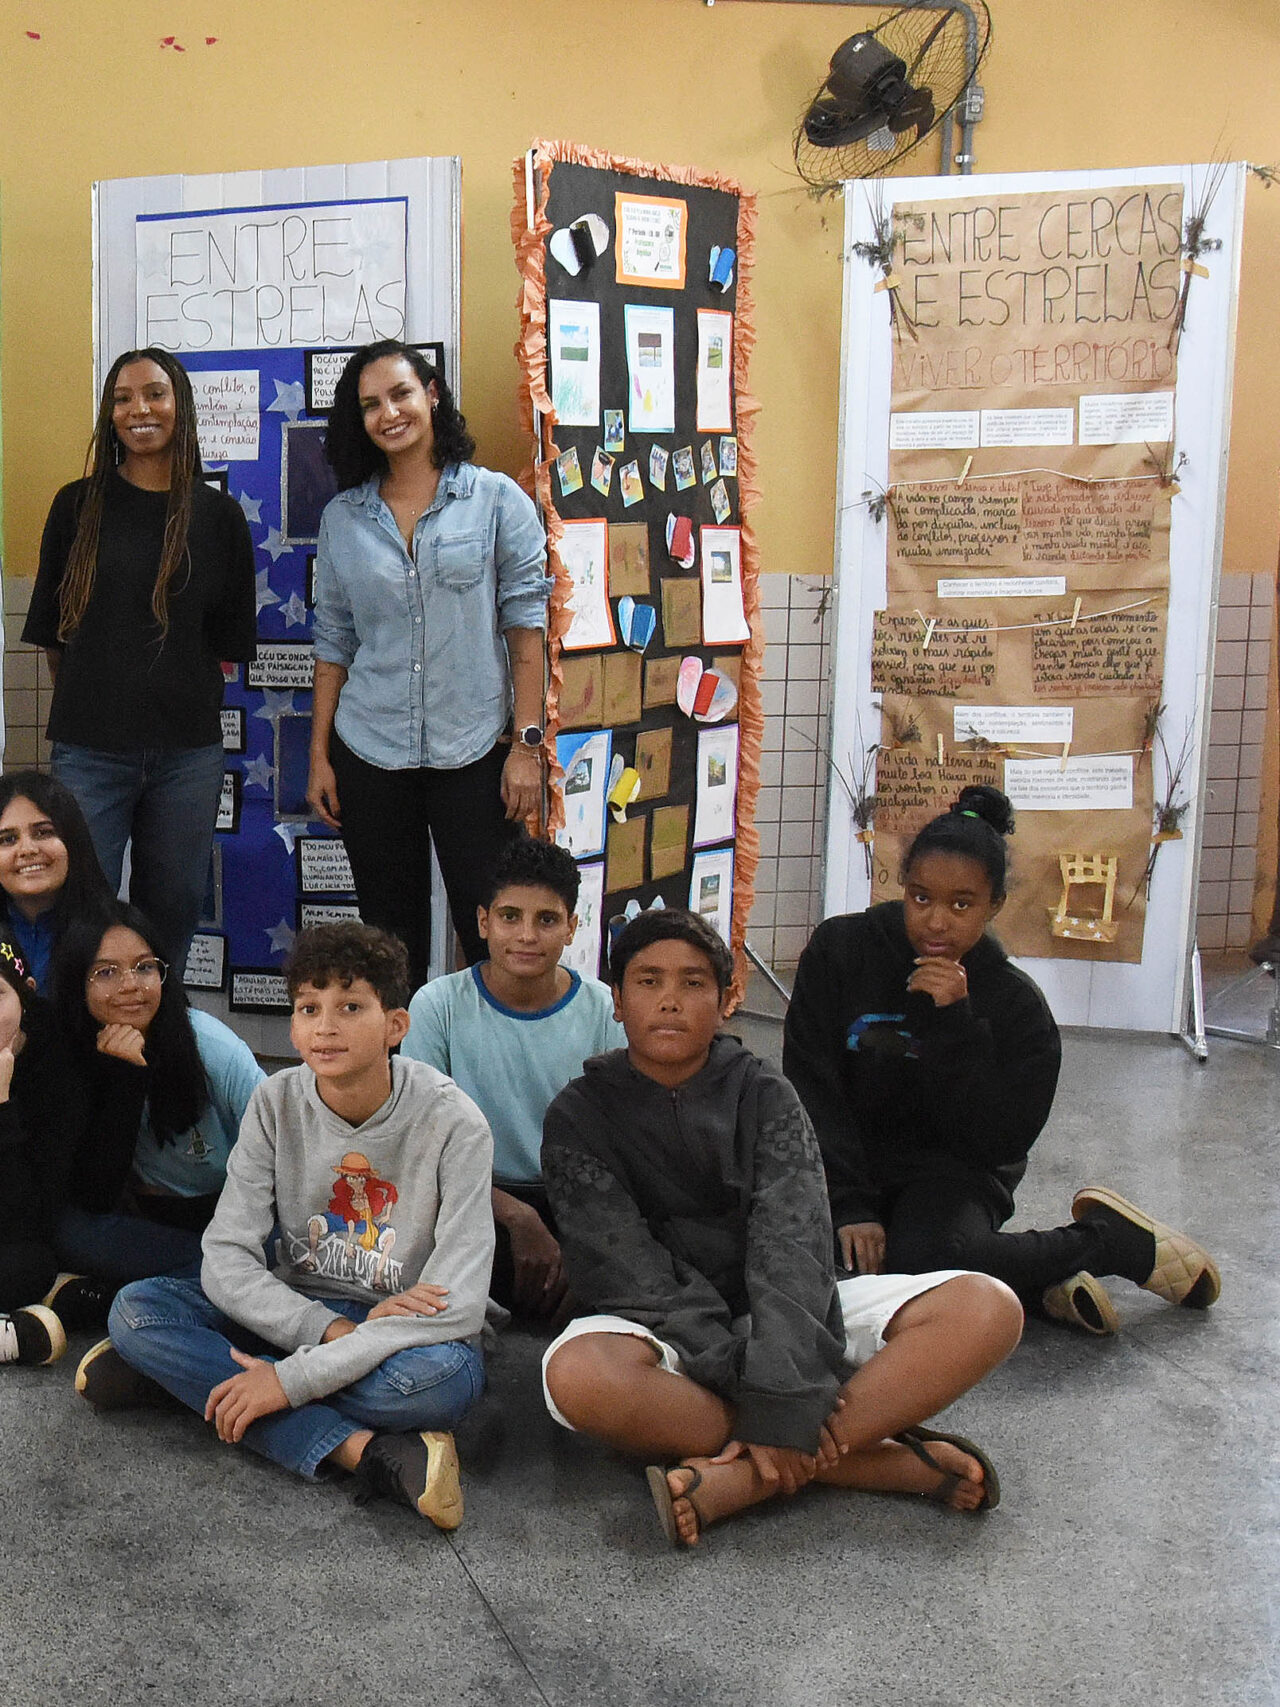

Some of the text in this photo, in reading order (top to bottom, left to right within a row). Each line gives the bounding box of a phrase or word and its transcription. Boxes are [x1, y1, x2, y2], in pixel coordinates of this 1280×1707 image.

[170, 215, 354, 287] ENTRE
[904, 192, 1181, 265] ENTRE CERCAS
[146, 280, 406, 350] ESTRELAS
[912, 259, 1179, 328] E ESTRELAS
[194, 396, 228, 411] ambém
[203, 376, 246, 398] conflitos,
[250, 385, 256, 394] o
[200, 447, 228, 460] tureza
